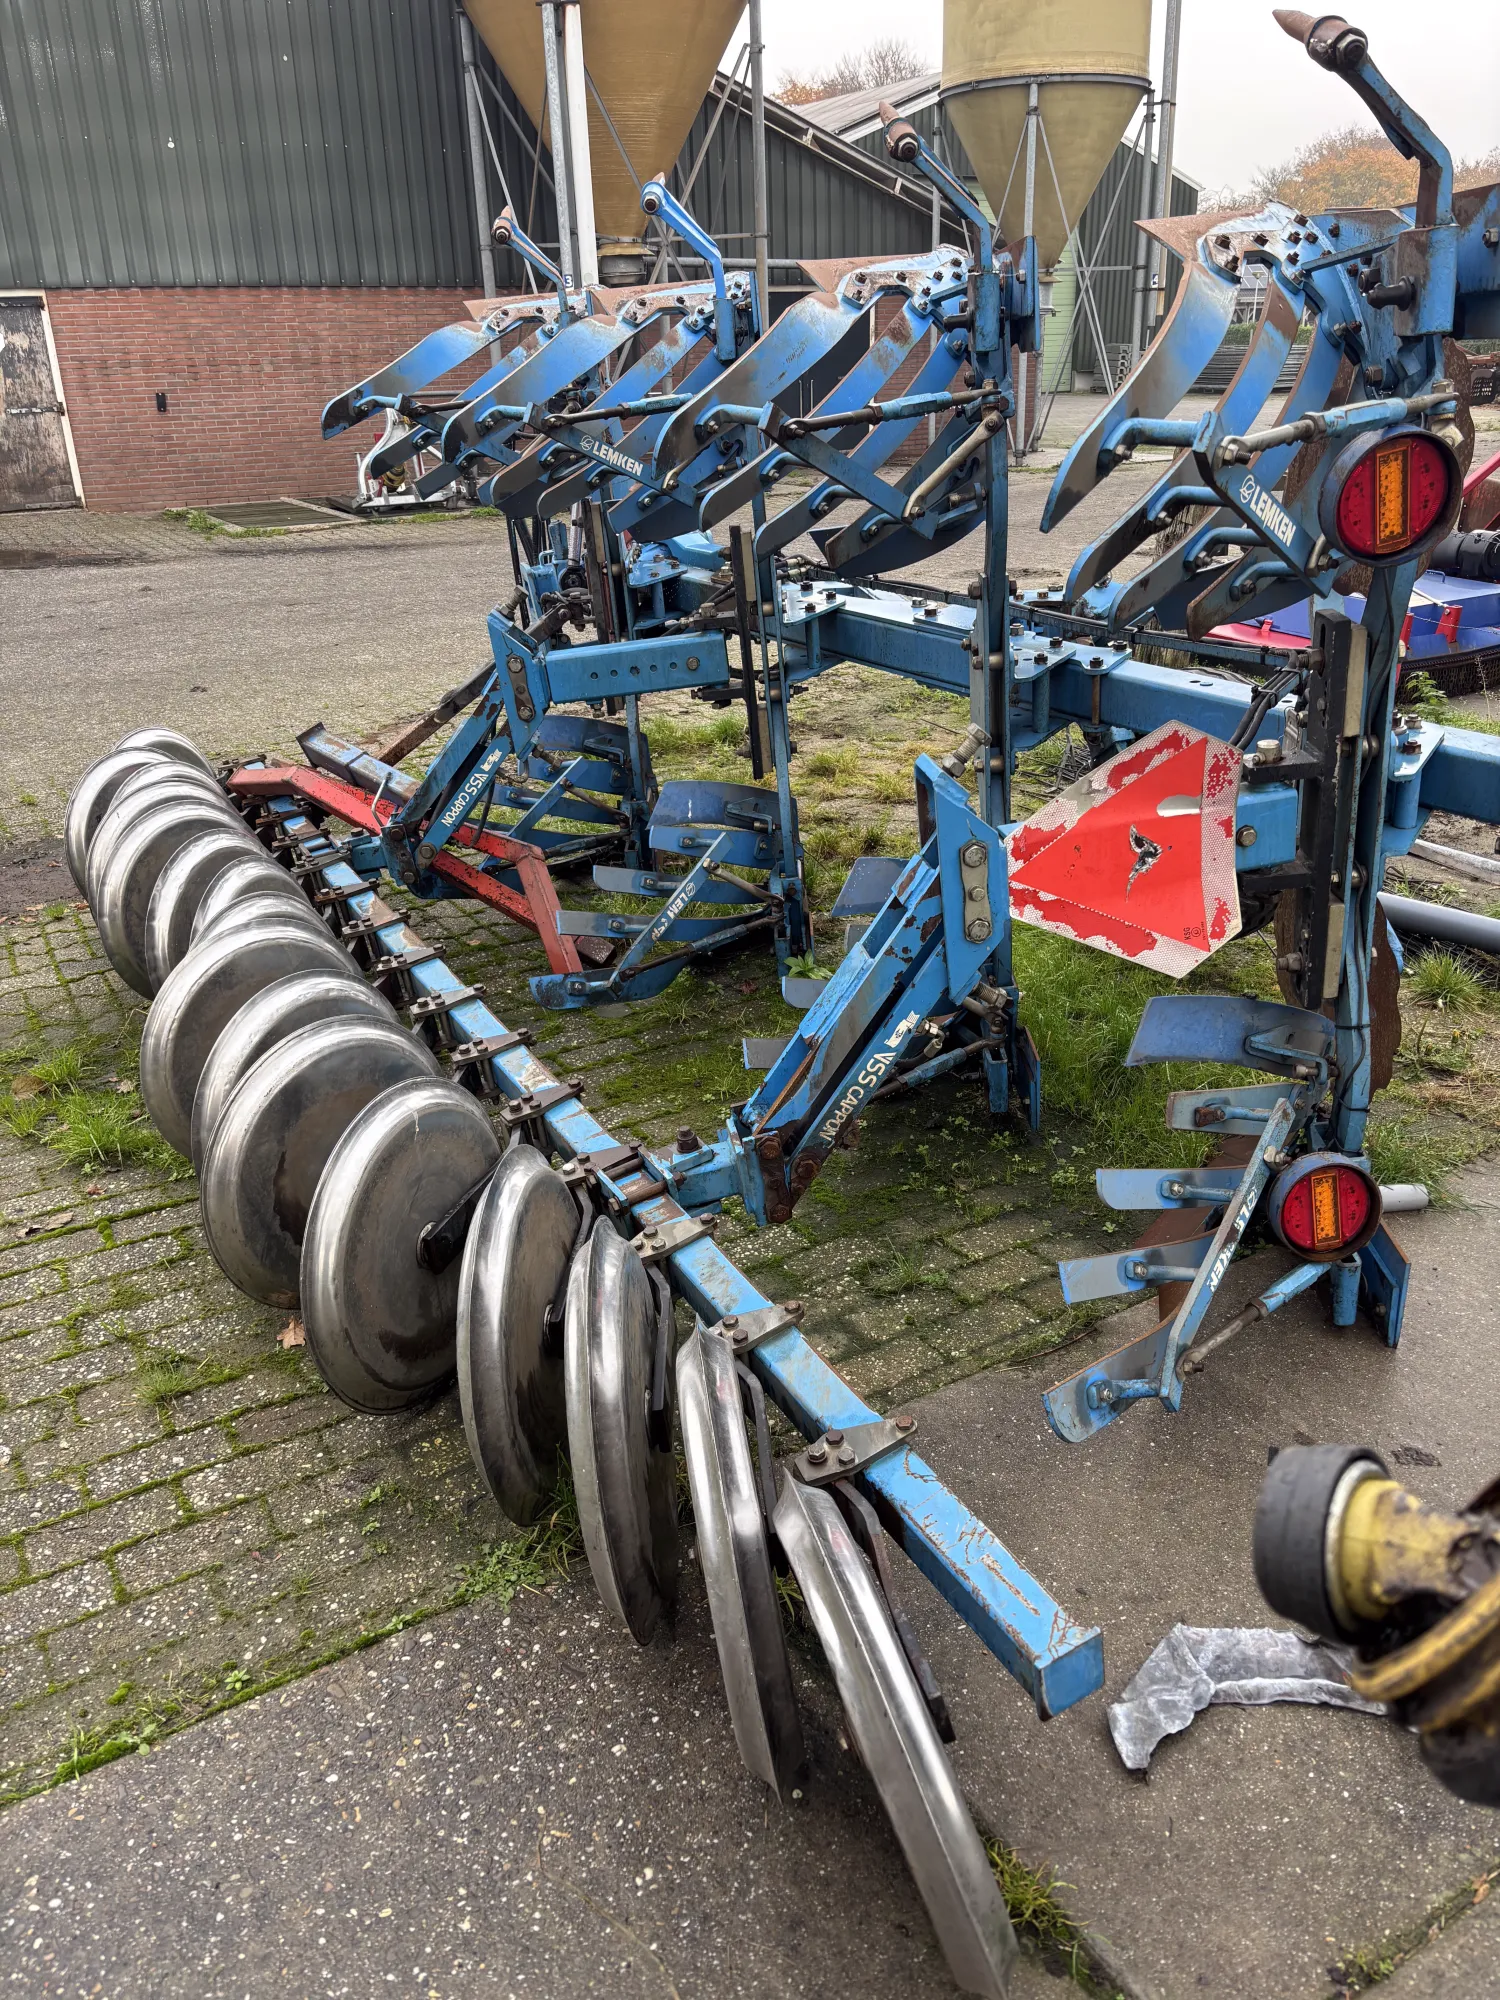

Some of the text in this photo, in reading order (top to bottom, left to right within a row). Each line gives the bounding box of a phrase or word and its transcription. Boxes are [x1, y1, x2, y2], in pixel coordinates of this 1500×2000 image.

[565, 275, 572, 287] 3
[592, 441, 643, 476] LEMKEN
[1250, 485, 1296, 547] LEMKEN
[441, 792, 470, 827] CAPPON
[1183, 926, 1191, 941] KSG
[819, 1086, 864, 1141] CAPPON
[1206, 1204, 1250, 1292] LEKEN
